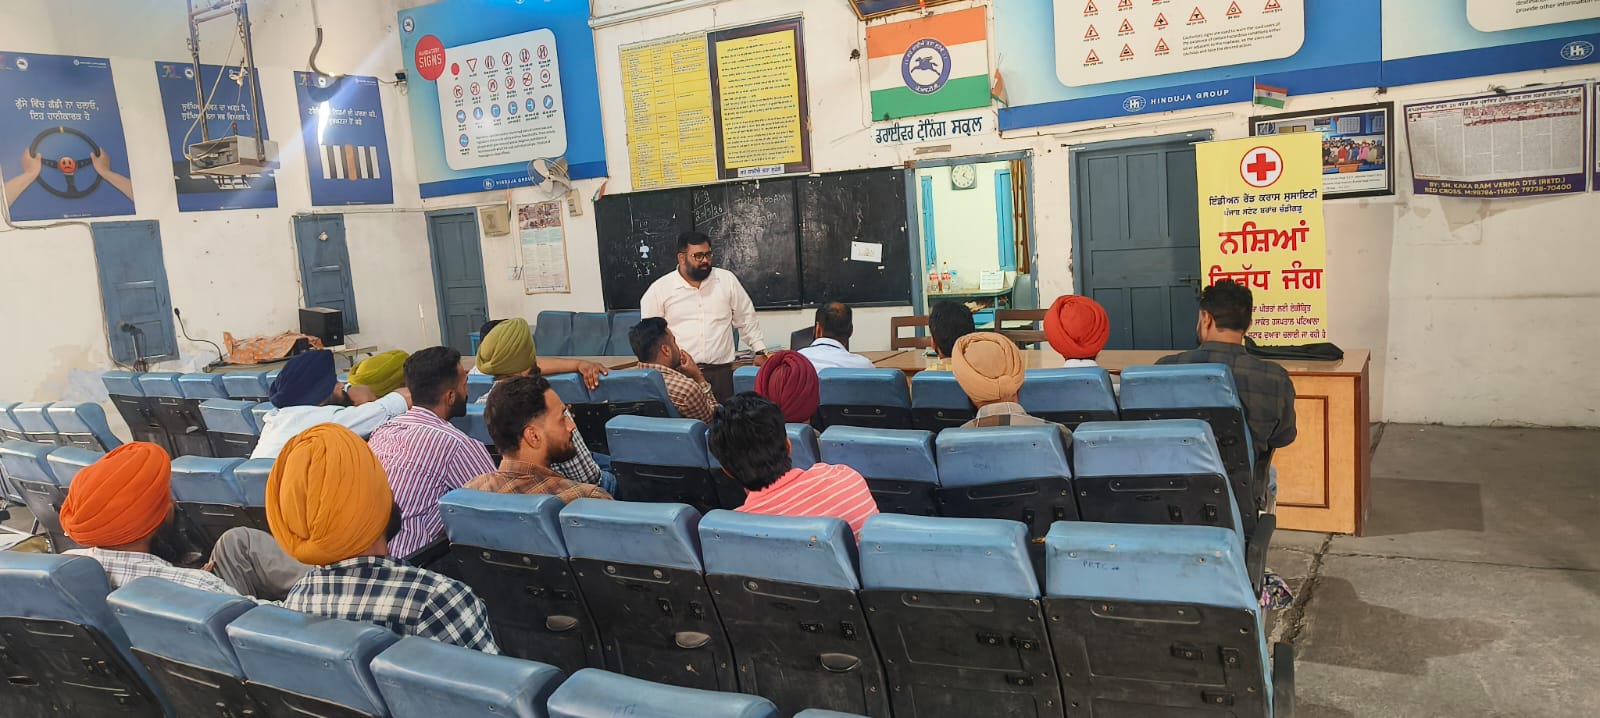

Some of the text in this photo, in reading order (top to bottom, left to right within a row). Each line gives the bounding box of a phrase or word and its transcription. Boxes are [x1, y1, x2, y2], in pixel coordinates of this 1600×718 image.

[419, 54, 442, 69] SIGNS
[1150, 94, 1192, 105] HINDUJA
[1195, 89, 1230, 99] GROUP
[1258, 192, 1280, 204] ਕਰਾਸ
[1223, 206, 1240, 217] ਪੰਜਾਬ
[1219, 220, 1310, 256] ਨਸ਼ਿਆਂ
[1281, 260, 1323, 291] ਜੰਗ
